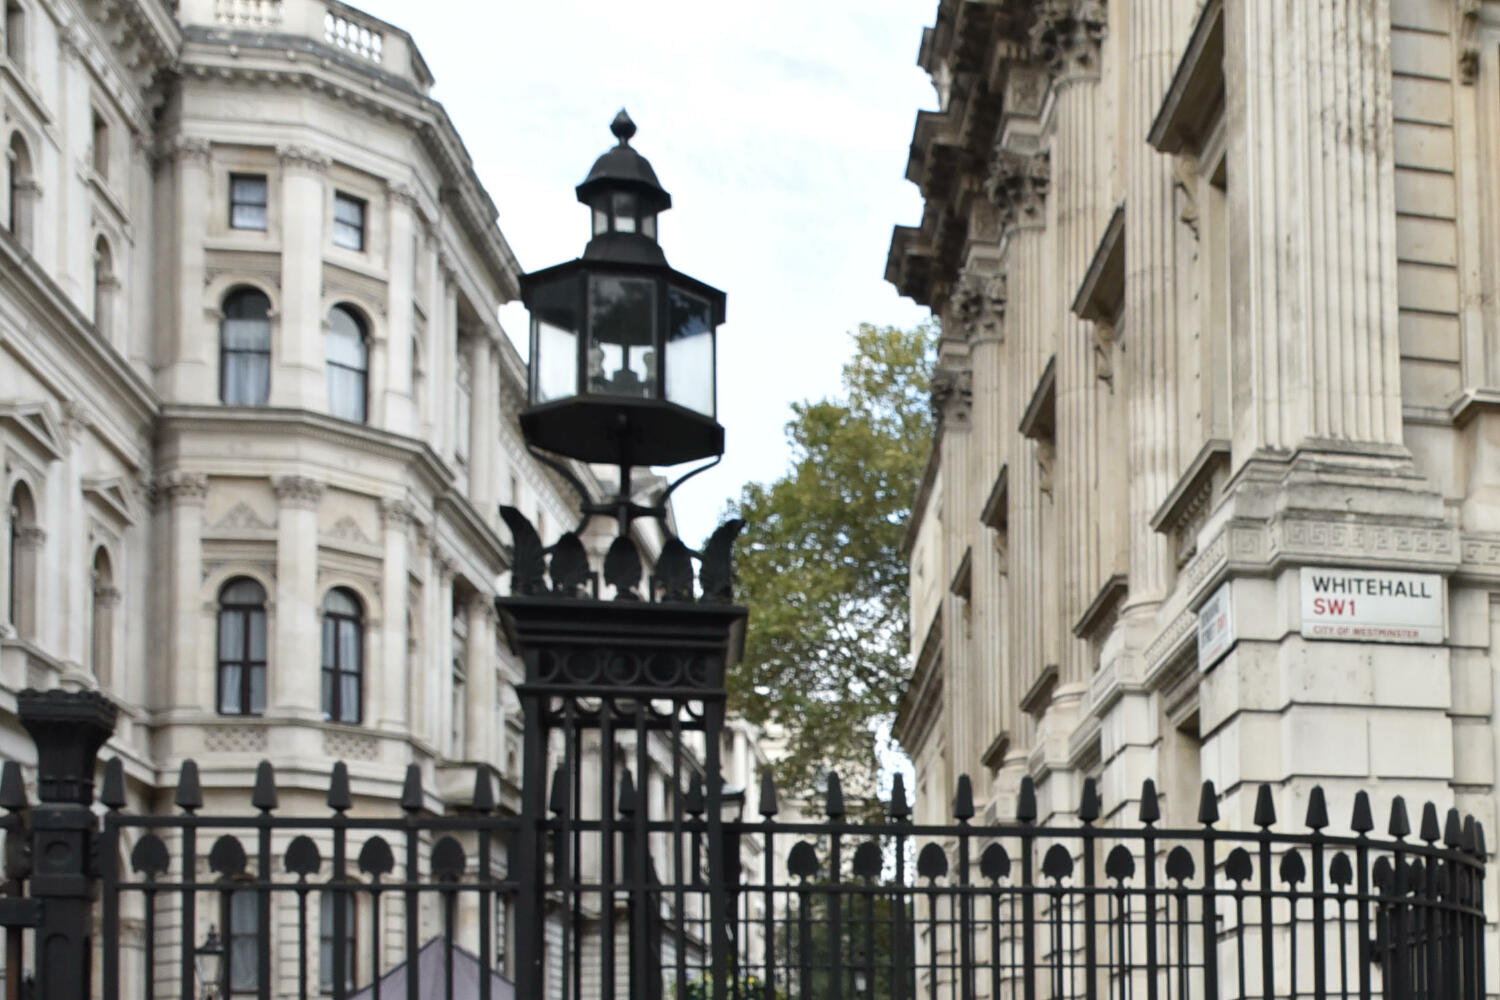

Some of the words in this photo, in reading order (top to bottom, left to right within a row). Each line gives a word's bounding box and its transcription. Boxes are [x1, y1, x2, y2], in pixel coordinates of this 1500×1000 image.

[1312, 576, 1432, 599] WHITEHALL
[1313, 598, 1355, 616] SW1
[1313, 625, 1334, 636] CITY
[1336, 626, 1350, 637] OF
[1353, 628, 1419, 639] WESTMINSTER
